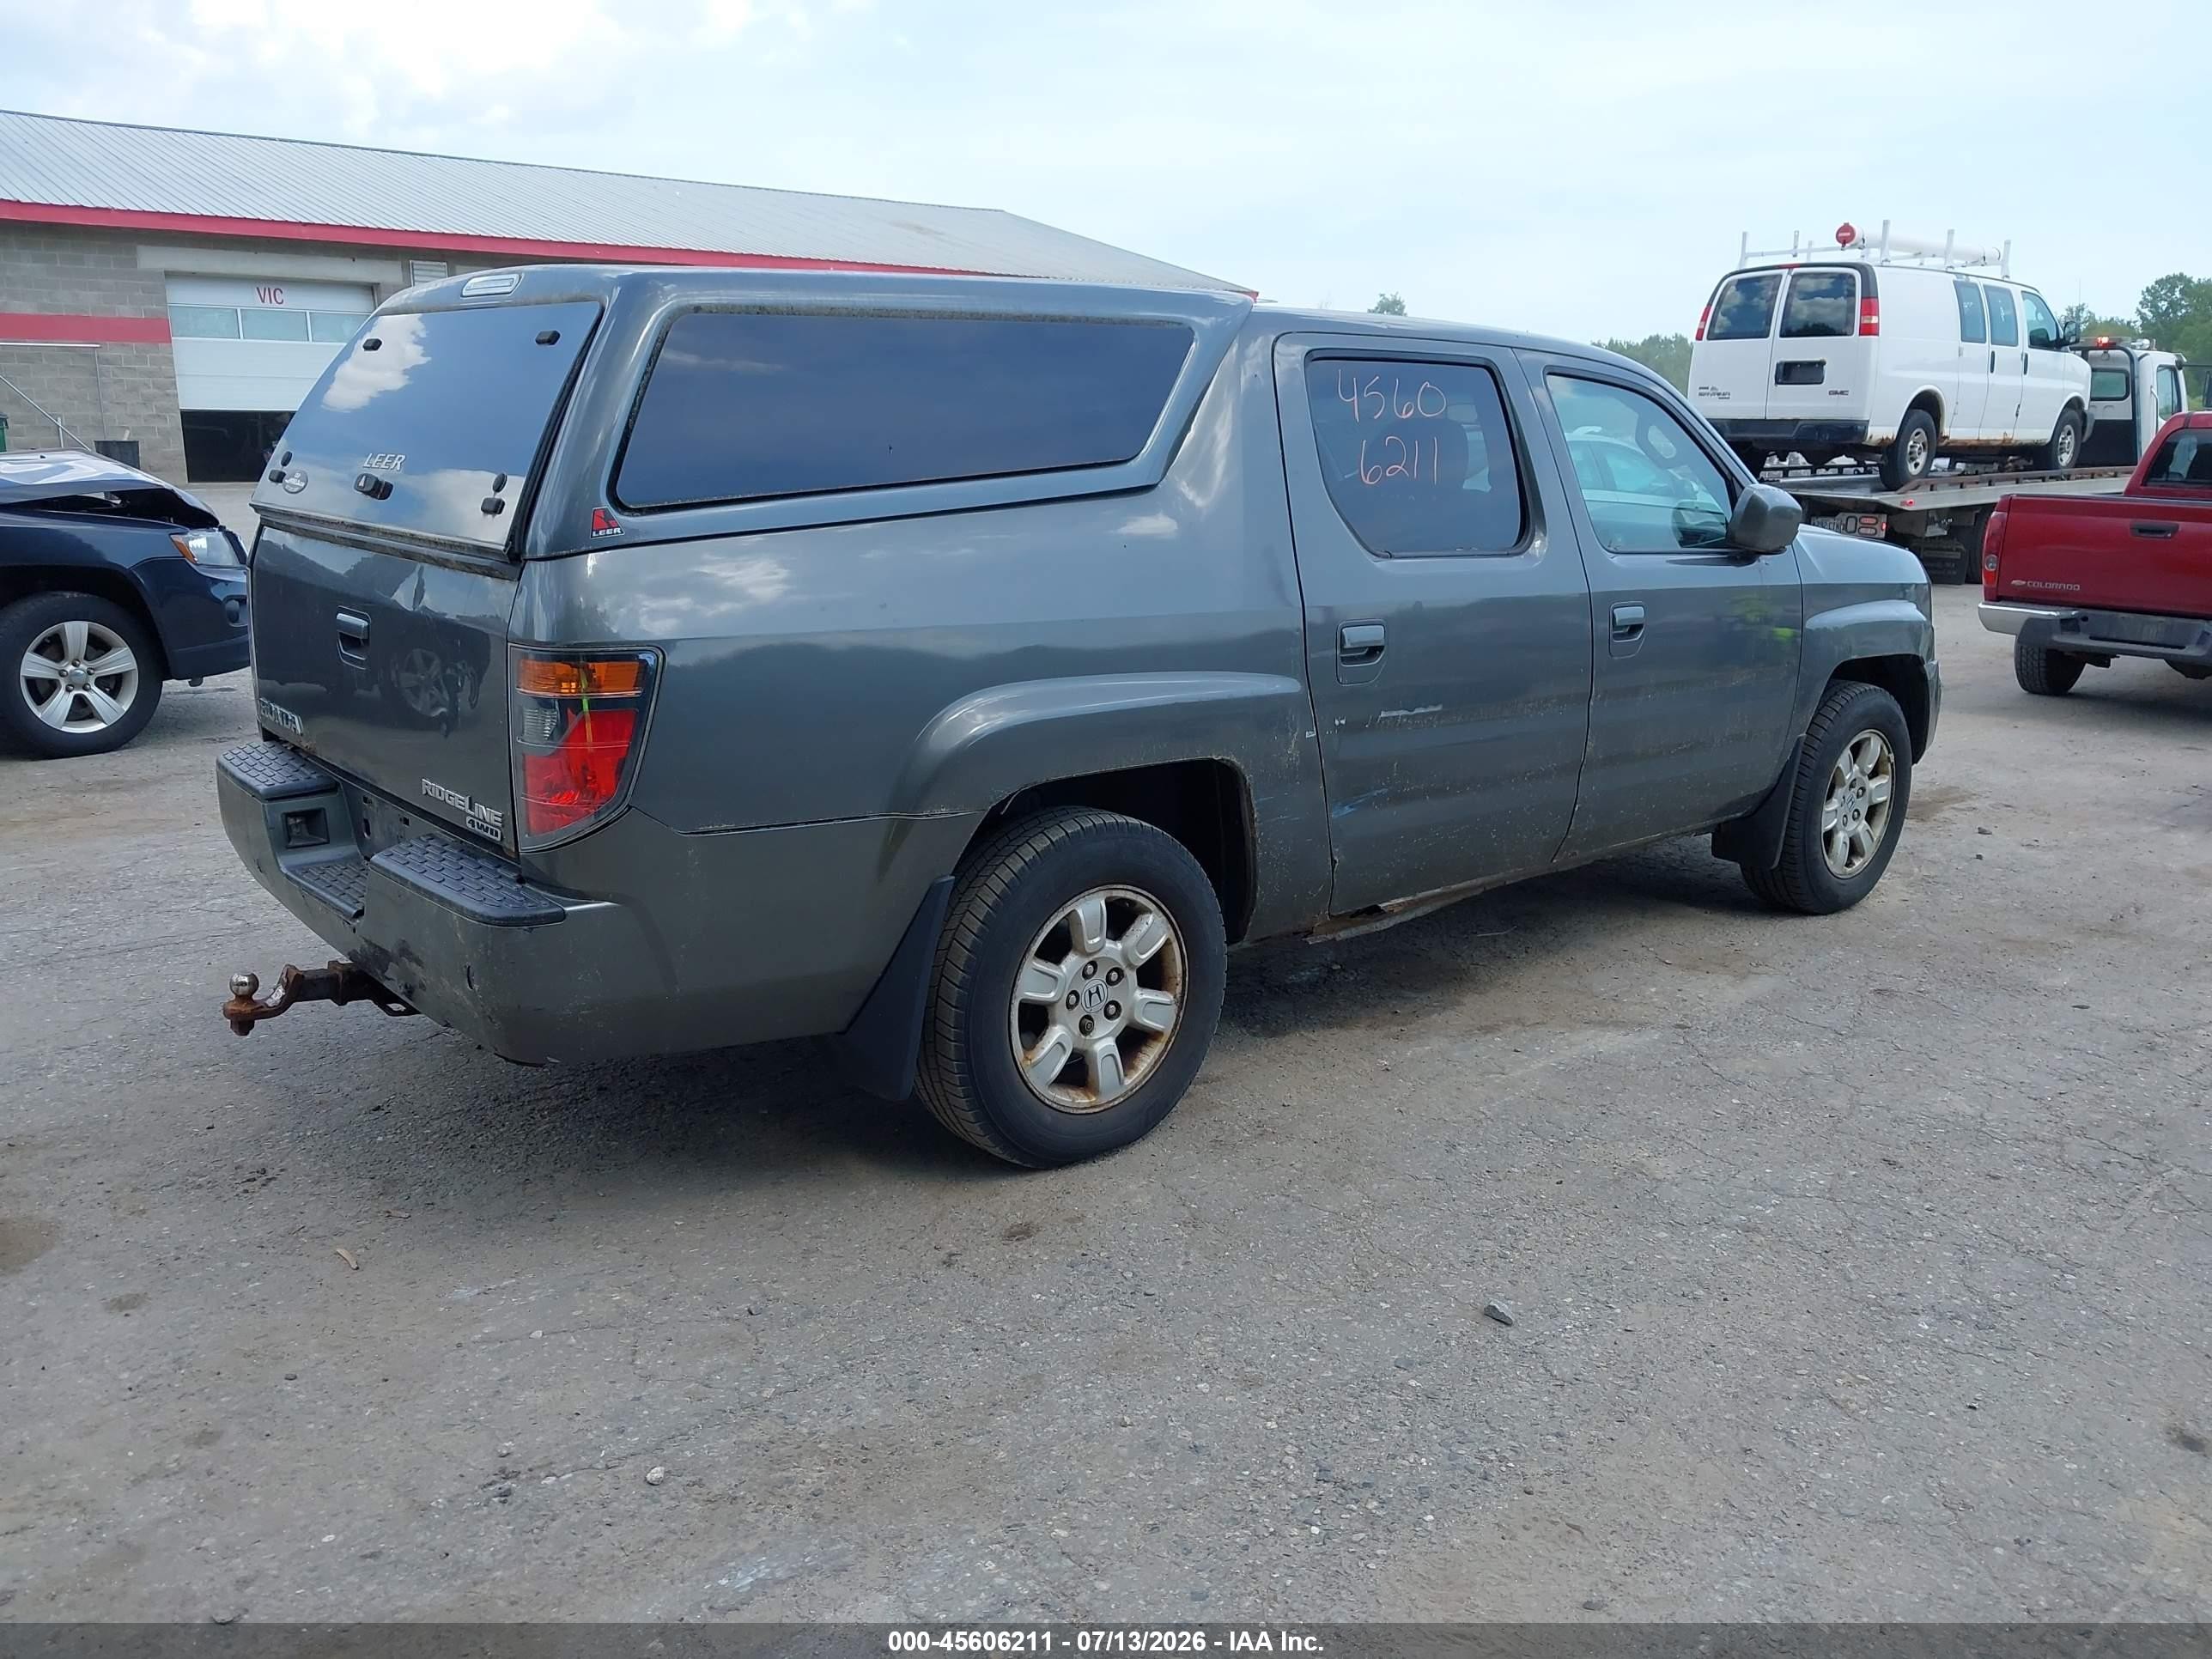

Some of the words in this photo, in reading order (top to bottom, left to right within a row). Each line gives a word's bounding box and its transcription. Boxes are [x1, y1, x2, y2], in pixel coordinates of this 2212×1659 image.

[256, 287, 284, 305] VIC
[1338, 368, 1447, 422] 4560
[363, 453, 406, 472] LEER
[1360, 435, 1437, 485] 6211
[592, 527, 622, 538] LEER
[2027, 580, 2081, 591] COLORADO
[421, 777, 503, 828] RIDGELINE
[466, 817, 501, 841] 4WD
